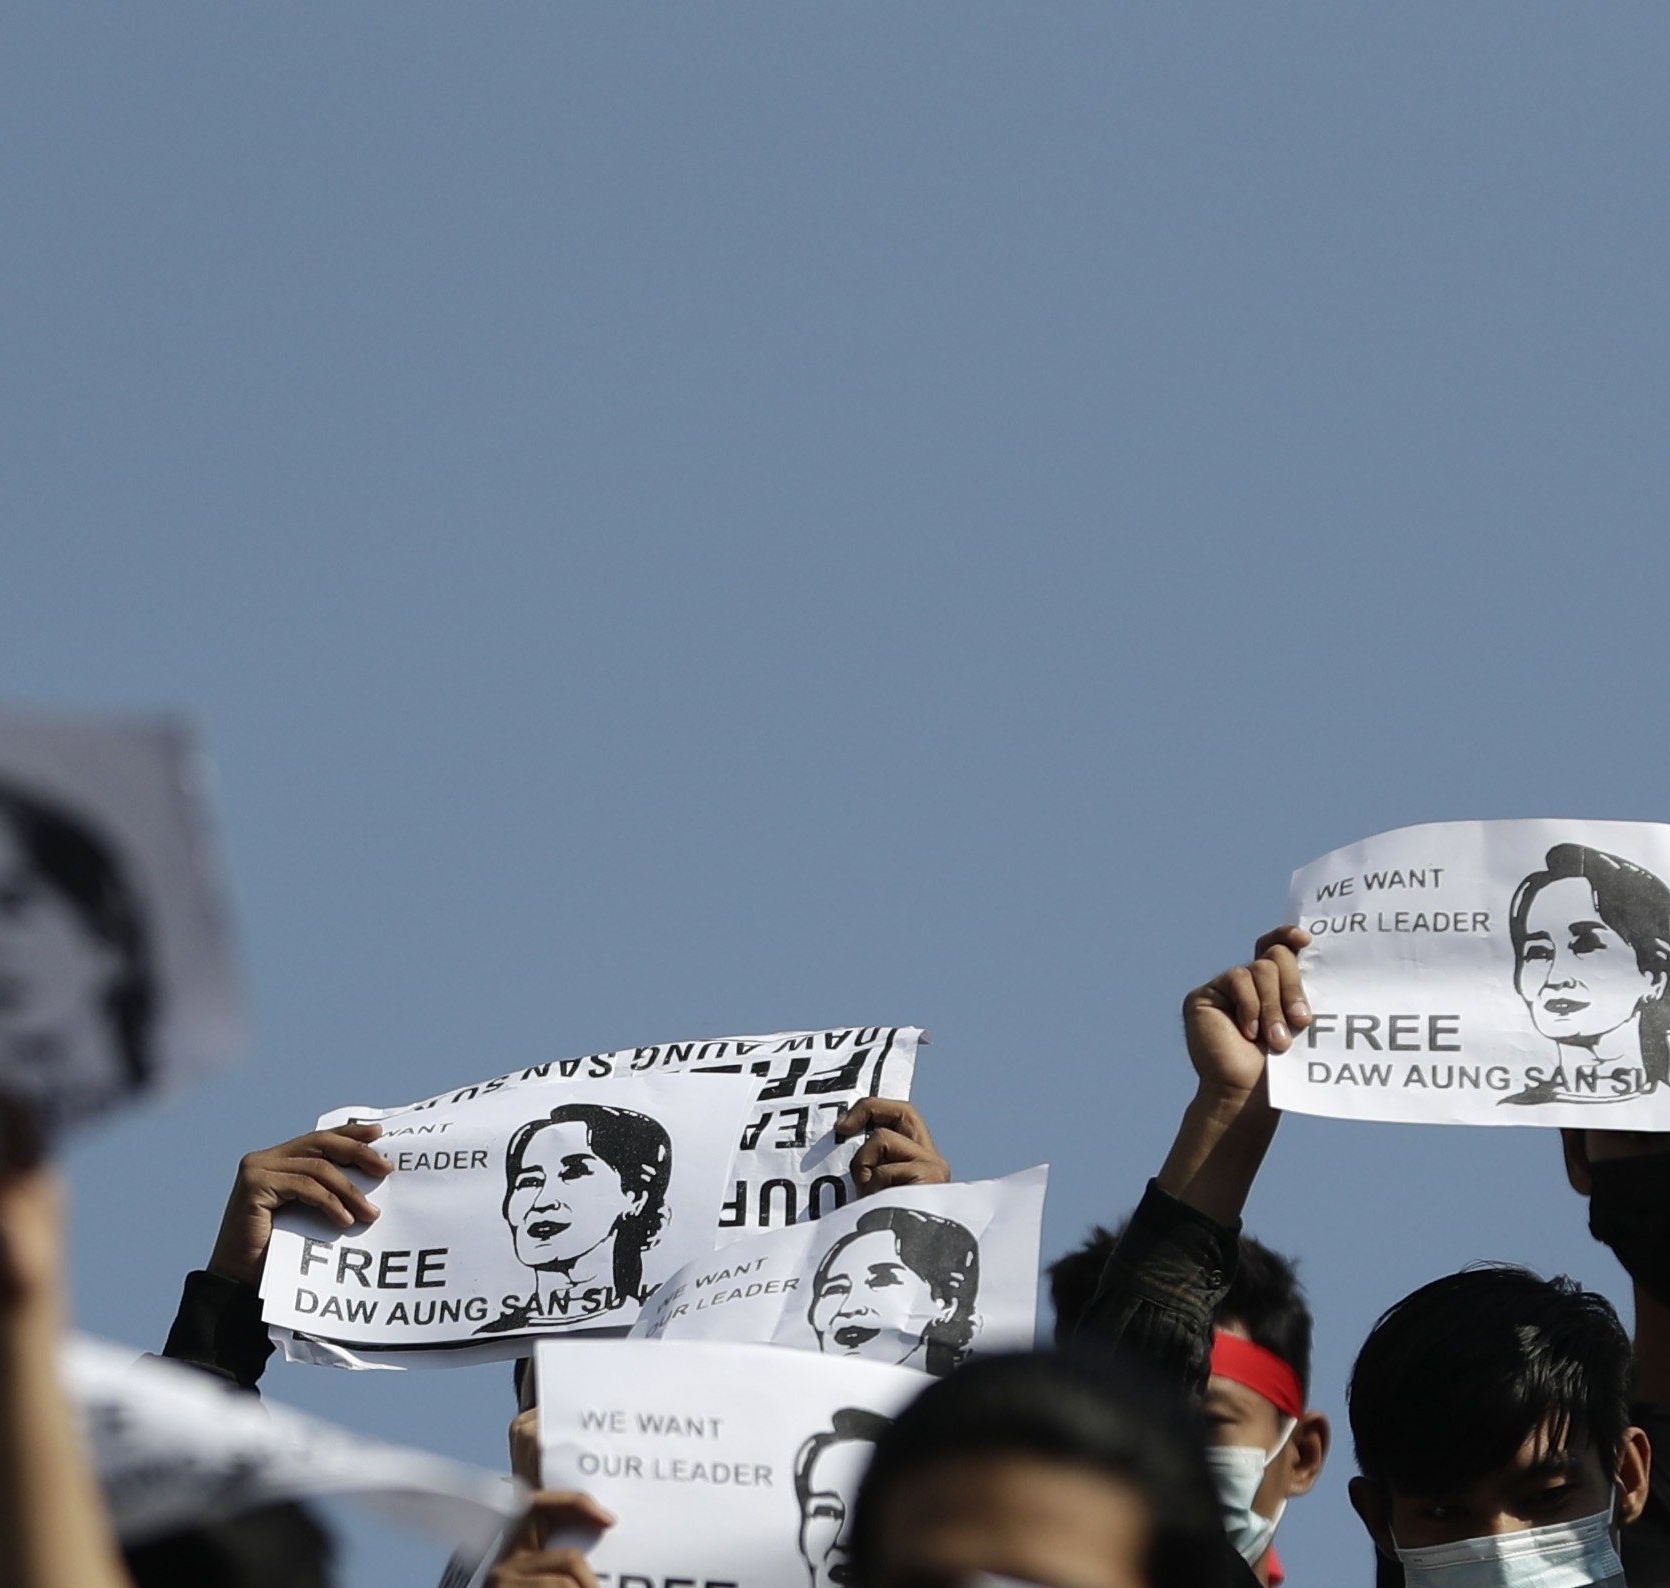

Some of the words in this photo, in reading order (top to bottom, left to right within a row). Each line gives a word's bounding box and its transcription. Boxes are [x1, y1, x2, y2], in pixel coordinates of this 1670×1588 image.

[1316, 877, 1354, 902] WE
[1363, 868, 1445, 891] WANT
[1309, 912, 1368, 936] OUR
[1378, 912, 1491, 933] LEADER
[1307, 1014, 1462, 1051] FREE
[1307, 1061, 1393, 1087] DAW
[1403, 1063, 1511, 1091] AUNG
[1524, 1065, 1597, 1093] SAN
[1611, 1067, 1659, 1095] SU
[383, 1150, 488, 1172] EADER
[299, 1239, 449, 1289] FREE
[656, 1284, 688, 1315] WE
[695, 1256, 769, 1289] WANT
[294, 1288, 379, 1325] DAW
[385, 1296, 488, 1326] AUNG
[501, 1290, 570, 1317] SAN
[581, 1286, 626, 1313] SU
[646, 1303, 689, 1338] OUR
[696, 1277, 801, 1310] LEADER
[579, 1410, 627, 1433] WE
[637, 1412, 724, 1439] WANT
[578, 1453, 643, 1479] OUR
[654, 1458, 774, 1487] LEADER
